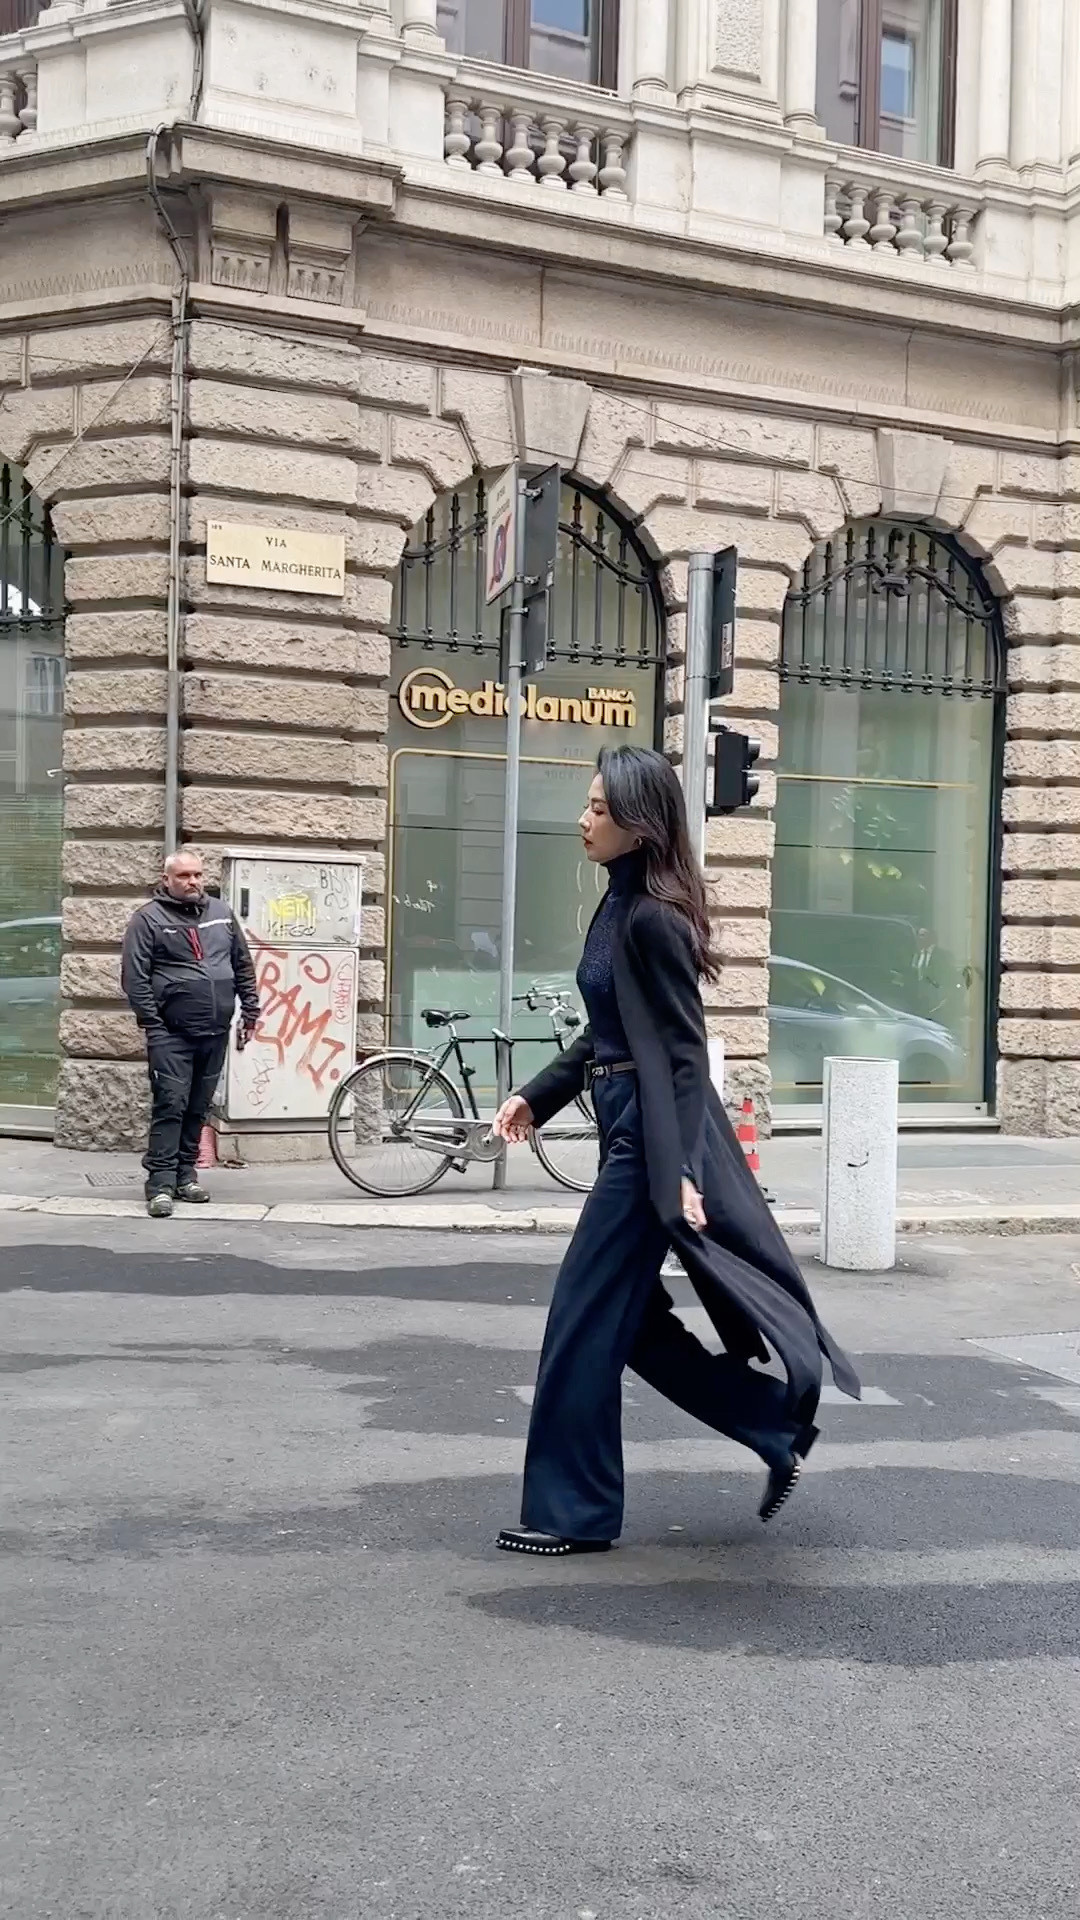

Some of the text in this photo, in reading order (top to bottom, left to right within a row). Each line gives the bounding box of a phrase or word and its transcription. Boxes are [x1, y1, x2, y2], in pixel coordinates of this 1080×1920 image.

[265, 536, 288, 548] VIA
[209, 554, 342, 579] SANTA MARGHERITA
[588, 687, 636, 702] BANCA
